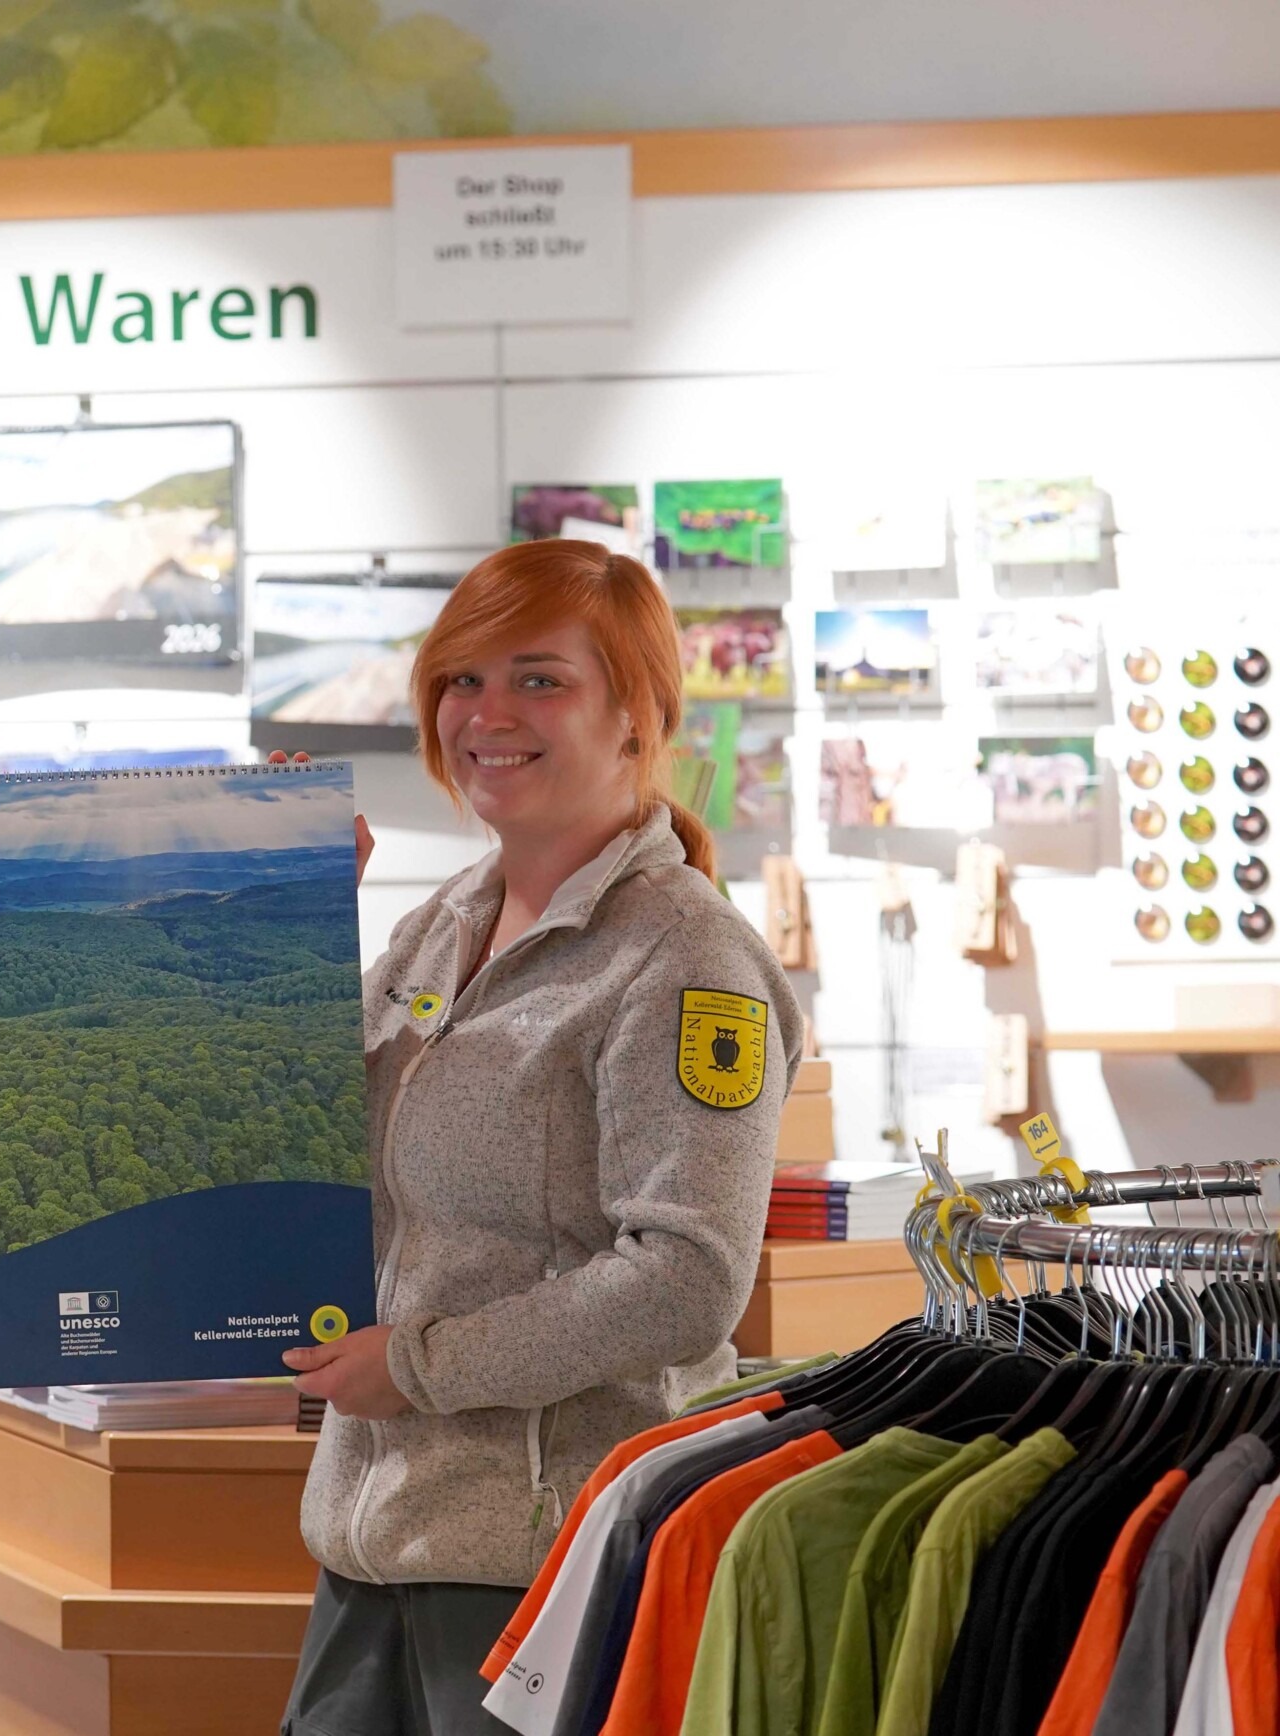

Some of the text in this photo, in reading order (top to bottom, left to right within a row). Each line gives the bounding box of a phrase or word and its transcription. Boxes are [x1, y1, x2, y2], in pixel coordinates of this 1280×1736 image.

[457, 174, 564, 198] Der Shop
[434, 244, 471, 261] um
[544, 236, 587, 258] Uhr
[20, 270, 320, 346] Waren
[161, 623, 222, 654] 2026
[683, 1017, 762, 1105] Nationalparkwacht
[1027, 1119, 1049, 1141] 164
[60, 1316, 120, 1330] unesco
[228, 1313, 300, 1326] Nationalpark
[194, 1328, 300, 1341] Kellerwald-Edersee
